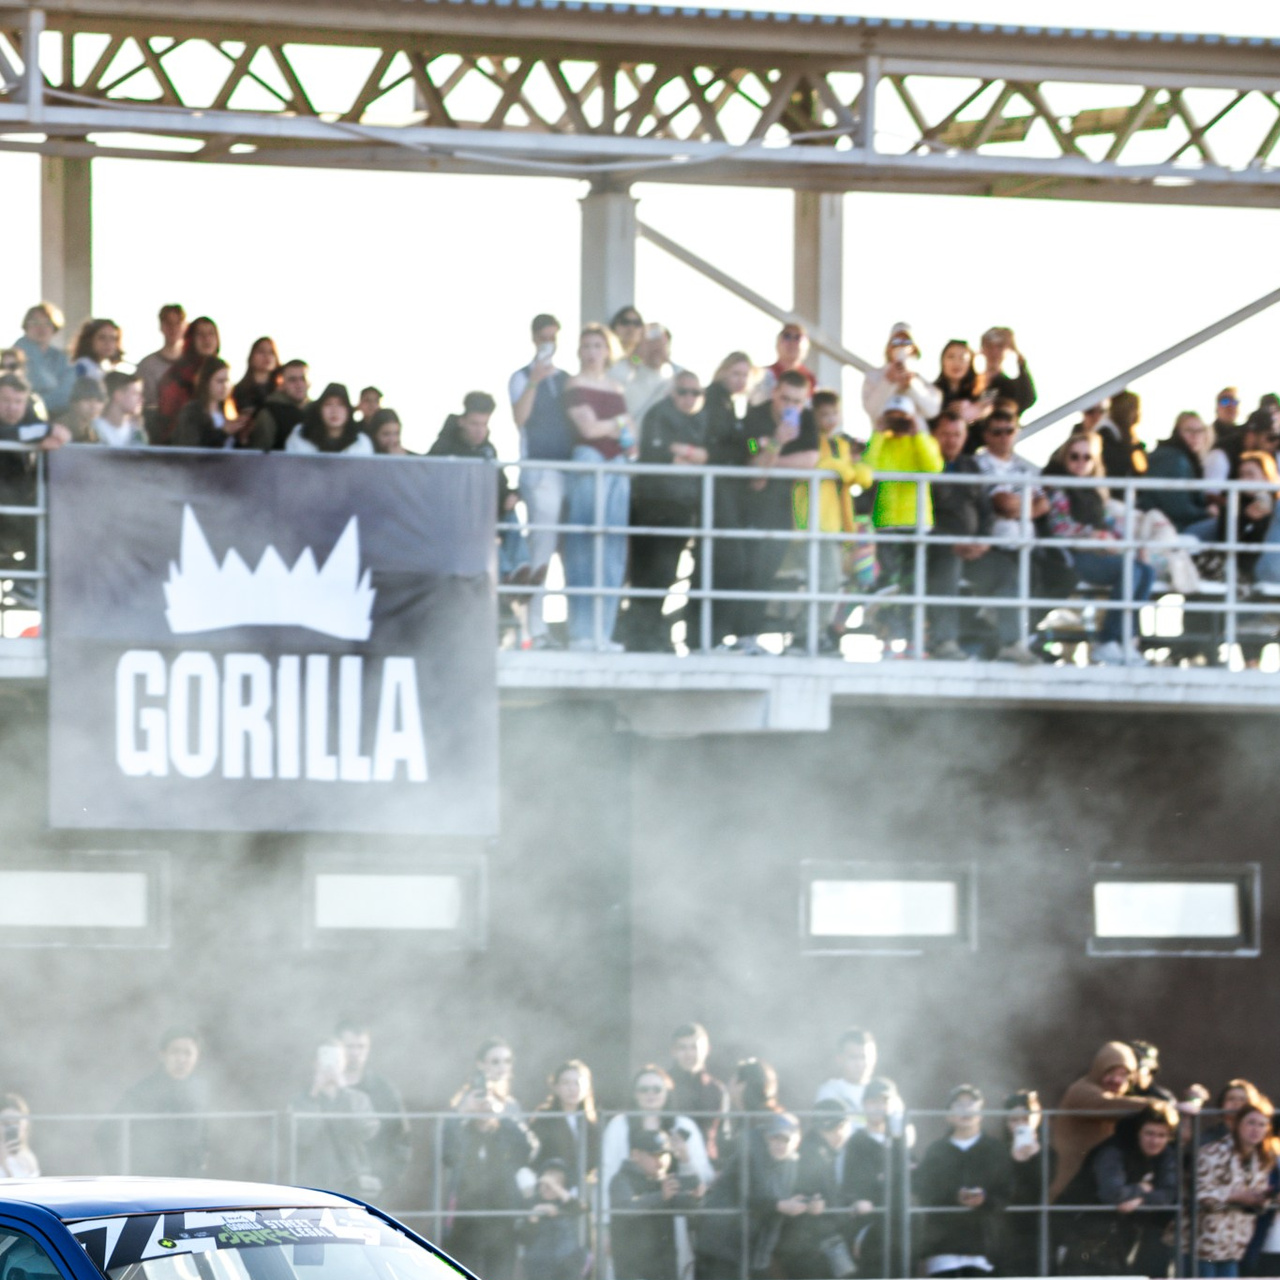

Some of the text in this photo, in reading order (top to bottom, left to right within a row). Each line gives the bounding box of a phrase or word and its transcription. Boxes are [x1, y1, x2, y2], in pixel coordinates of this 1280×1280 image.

[115, 649, 429, 783] GORILLA
[263, 1218, 316, 1230] STREET
[288, 1226, 337, 1238] LEGAL
